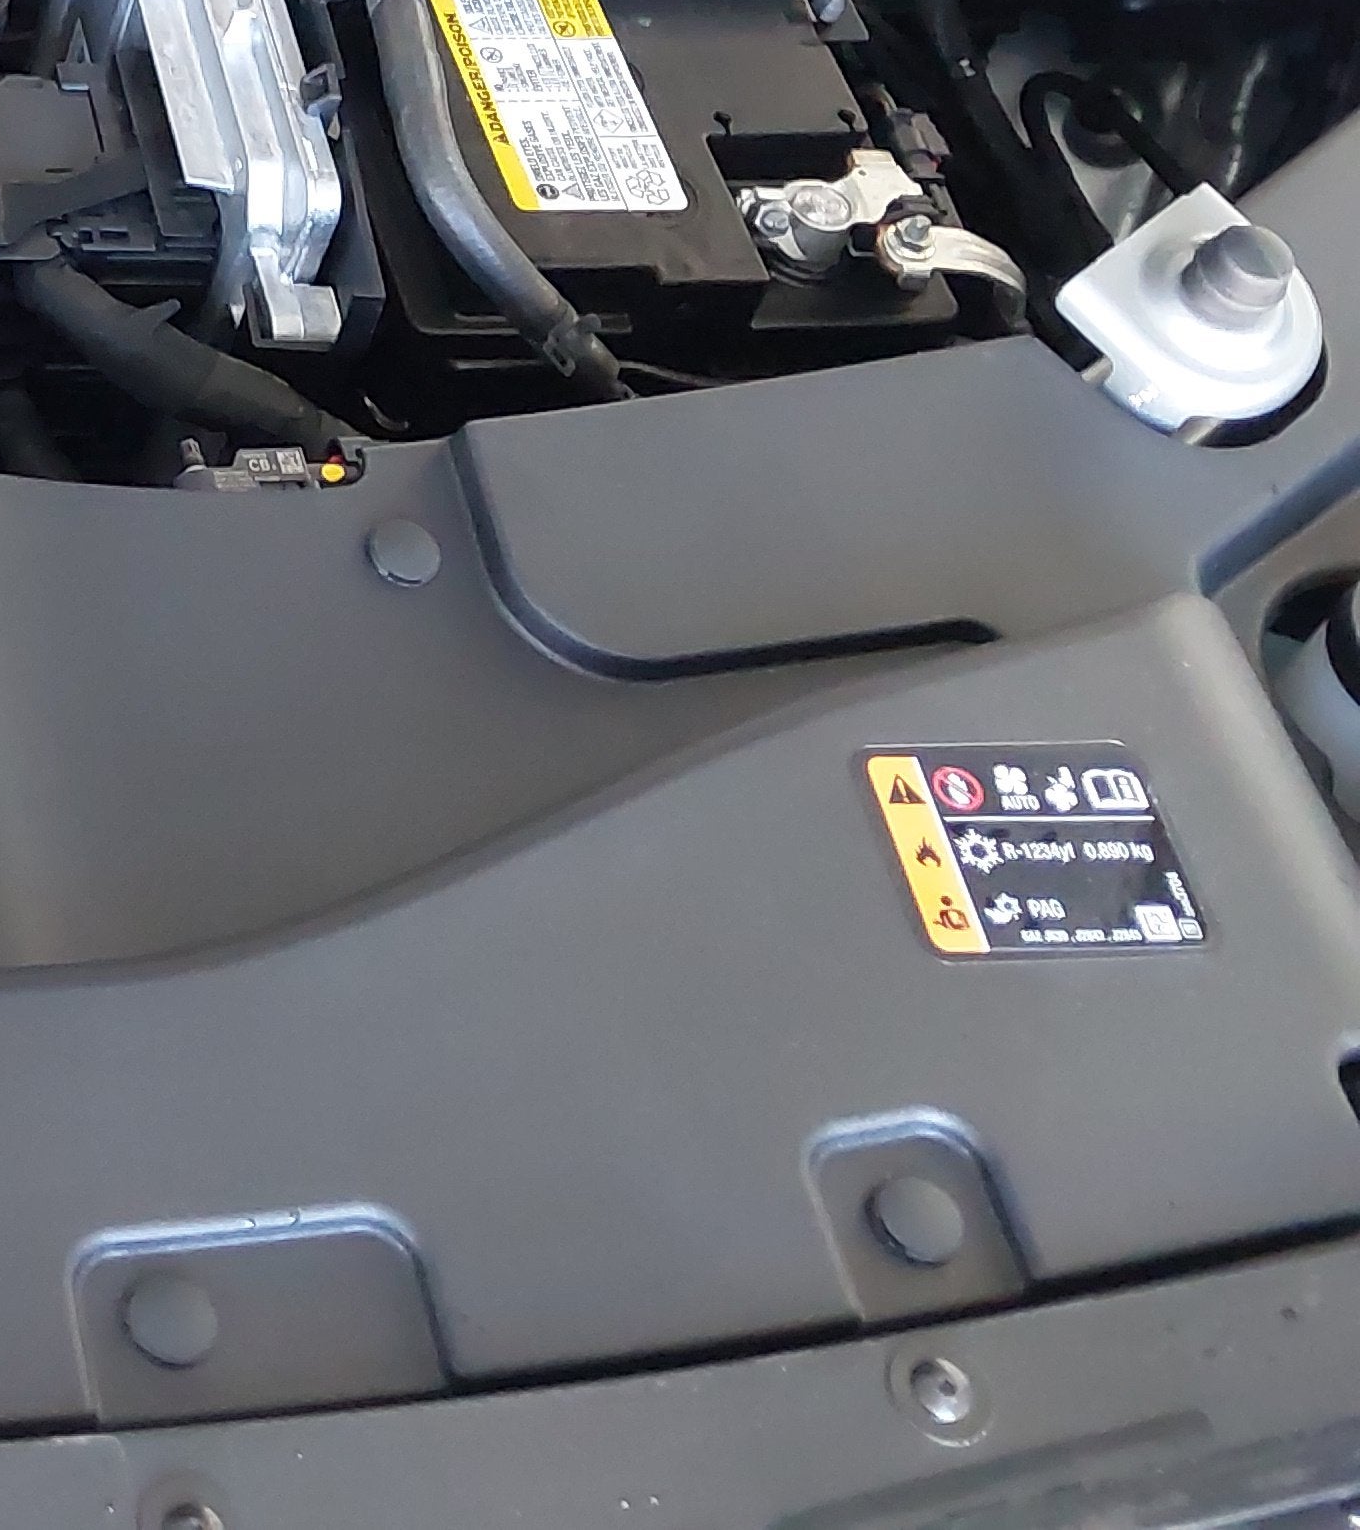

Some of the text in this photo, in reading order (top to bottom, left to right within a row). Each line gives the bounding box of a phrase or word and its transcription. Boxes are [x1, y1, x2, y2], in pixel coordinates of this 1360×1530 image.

[443, 12, 506, 132] DANGER/POISON
[1001, 795, 1040, 811] AUTO
[1129, 841, 1155, 863] kg
[1026, 898, 1066, 919] PAG
